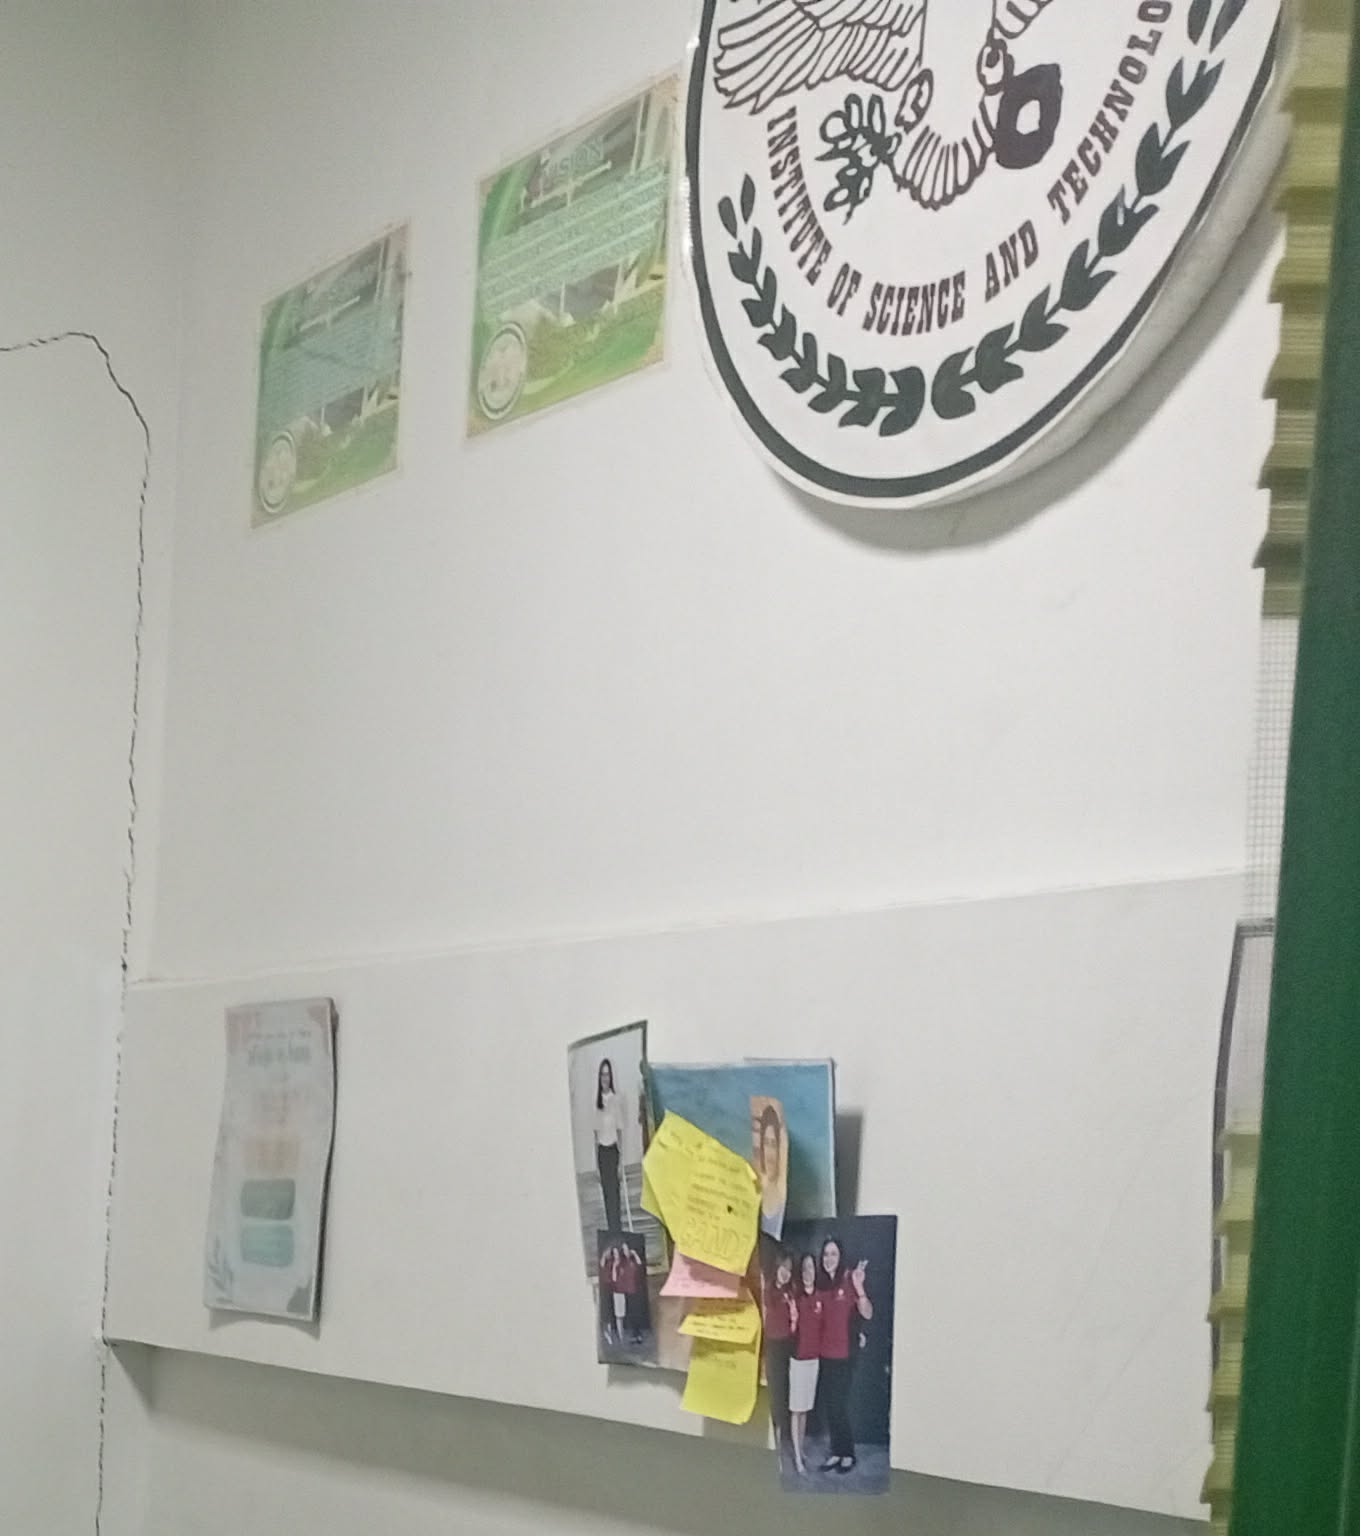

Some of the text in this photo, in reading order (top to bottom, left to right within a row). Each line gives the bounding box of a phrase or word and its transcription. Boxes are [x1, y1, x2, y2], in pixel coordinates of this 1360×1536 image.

[767, 106, 833, 287] INSTITUTE
[827, 262, 862, 317] OF
[862, 270, 966, 337] SCIENCE
[985, 220, 1040, 303] AND
